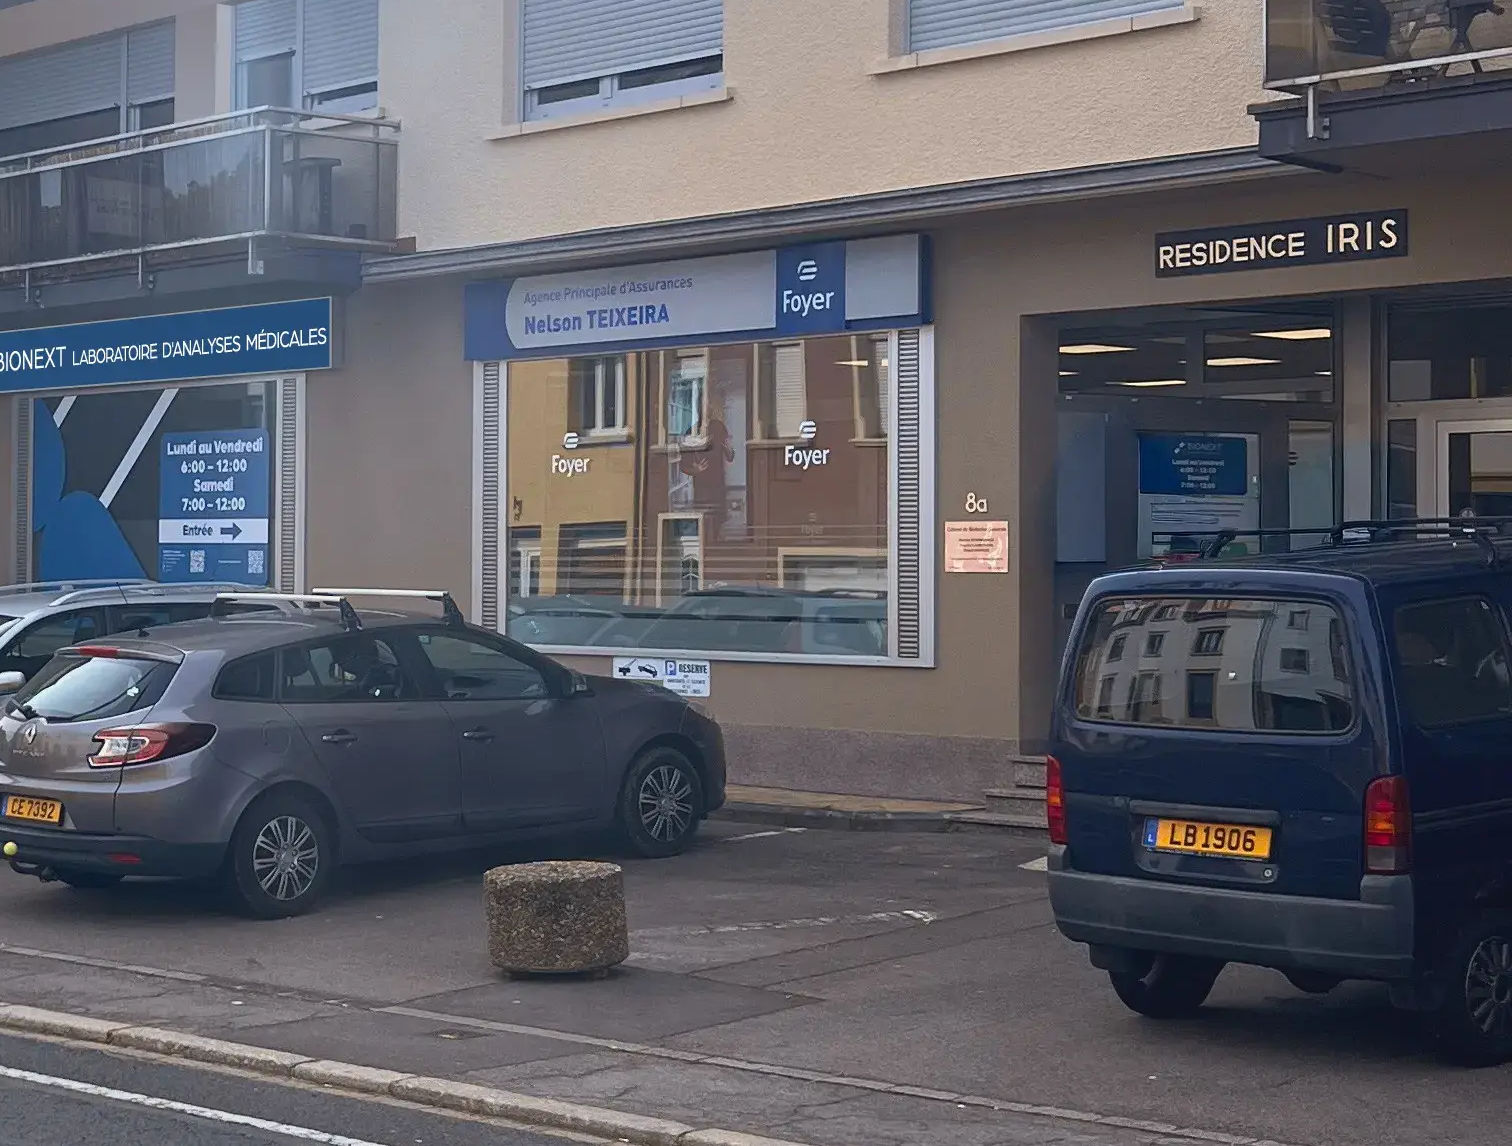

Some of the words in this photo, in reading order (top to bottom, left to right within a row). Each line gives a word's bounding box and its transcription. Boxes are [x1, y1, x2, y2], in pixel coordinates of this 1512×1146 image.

[1159, 232, 1305, 269] RESIDENCE
[1327, 219, 1398, 253] IRIS
[524, 289, 561, 306] Agence
[563, 282, 617, 302] Principale
[619, 276, 693, 295] d'Assurances
[782, 290, 835, 317] Foyer
[524, 312, 582, 335] Nelson
[587, 304, 670, 330] TEIXEIRA
[72, 343, 158, 366] LABORATOIRE
[162, 335, 241, 359] D'ANALYSES
[246, 327, 327, 351] MÉDICALES
[167, 440, 197, 455] Lundi
[198, 444, 213, 454] au
[214, 437, 263, 454] Vendredi
[784, 445, 830, 470] Foyer
[181, 459, 205, 473] 6:00
[216, 458, 247, 473] 12:00
[551, 454, 591, 477] Foyer
[194, 476, 234, 492] Samedi
[182, 497, 205, 511] 7:00
[215, 497, 246, 511] 12:00
[965, 492, 988, 513] 8a
[182, 523, 213, 536] Entrée
